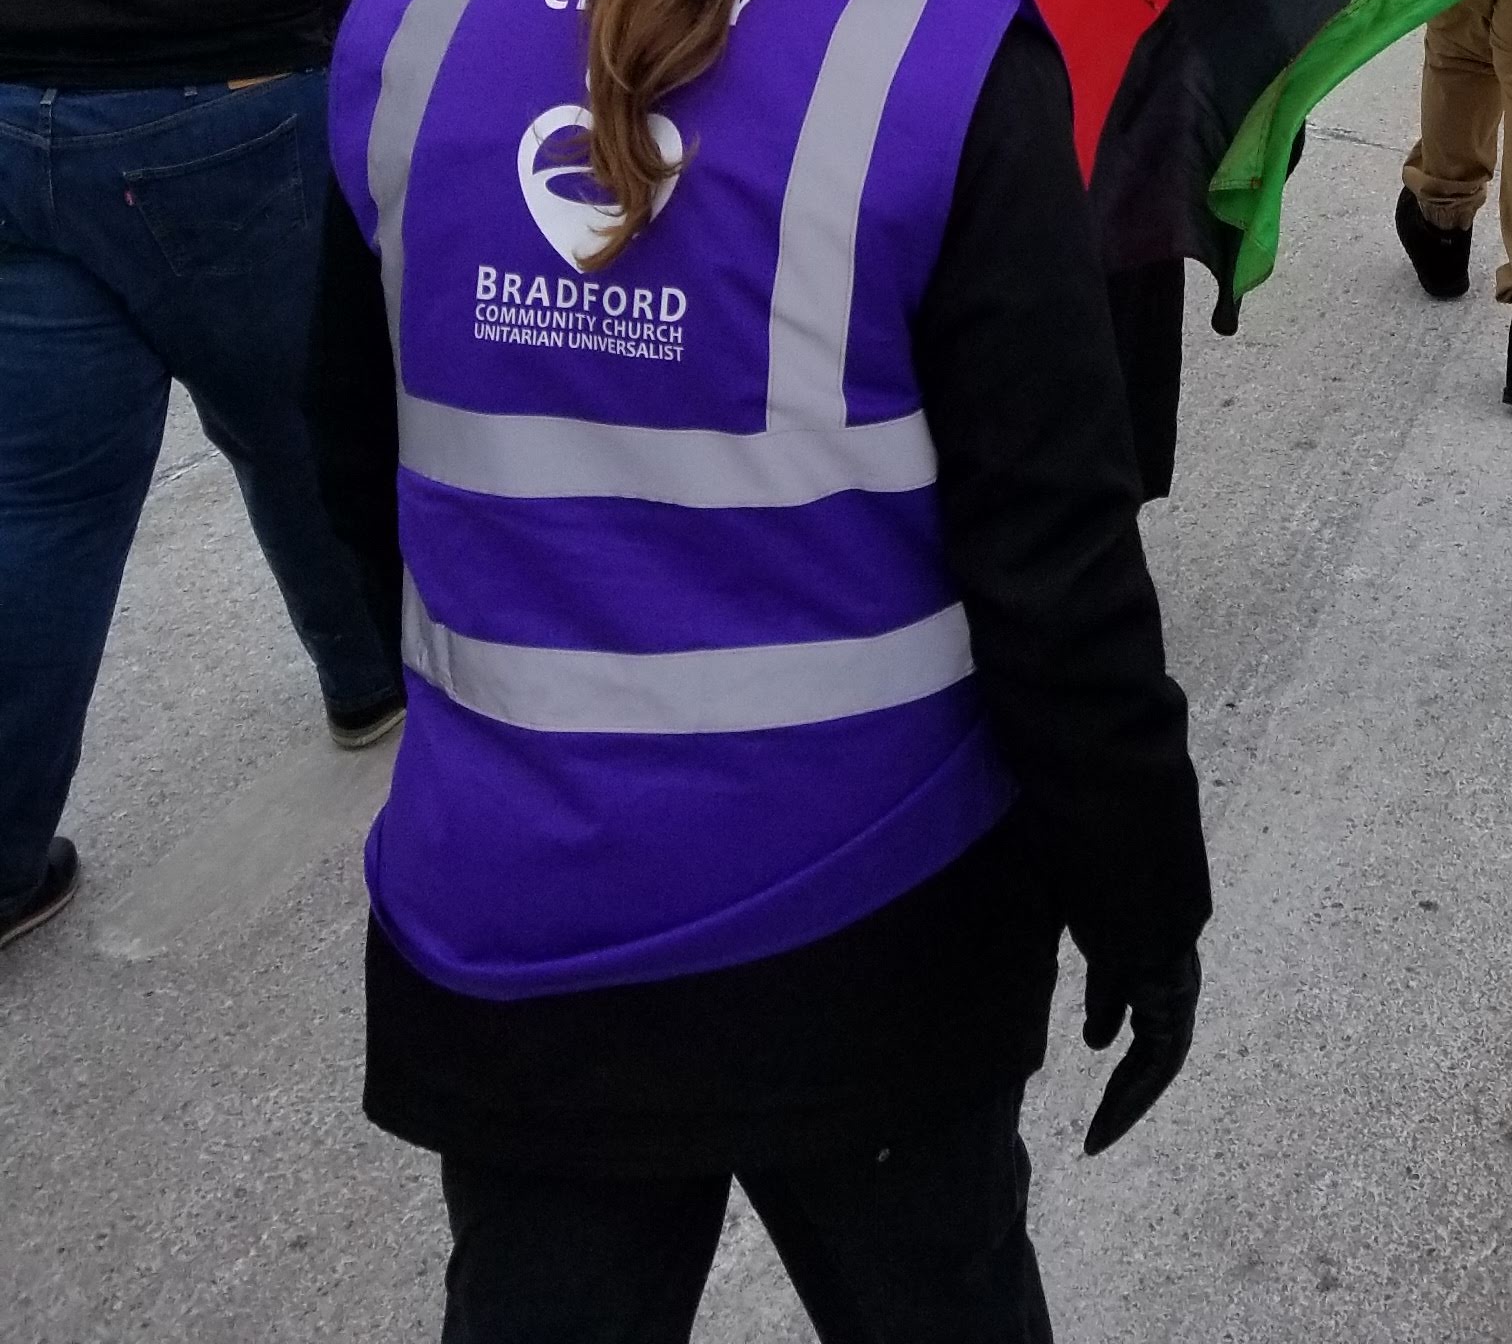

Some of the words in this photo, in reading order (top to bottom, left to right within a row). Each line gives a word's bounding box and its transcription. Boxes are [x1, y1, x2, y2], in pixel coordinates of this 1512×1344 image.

[476, 264, 688, 324] BRADFORD
[474, 322, 564, 348] UNITARIAN
[568, 332, 685, 362] UNIVERSALIST
[475, 302, 598, 332] COMMUNITY
[602, 318, 683, 344] CHURCH
